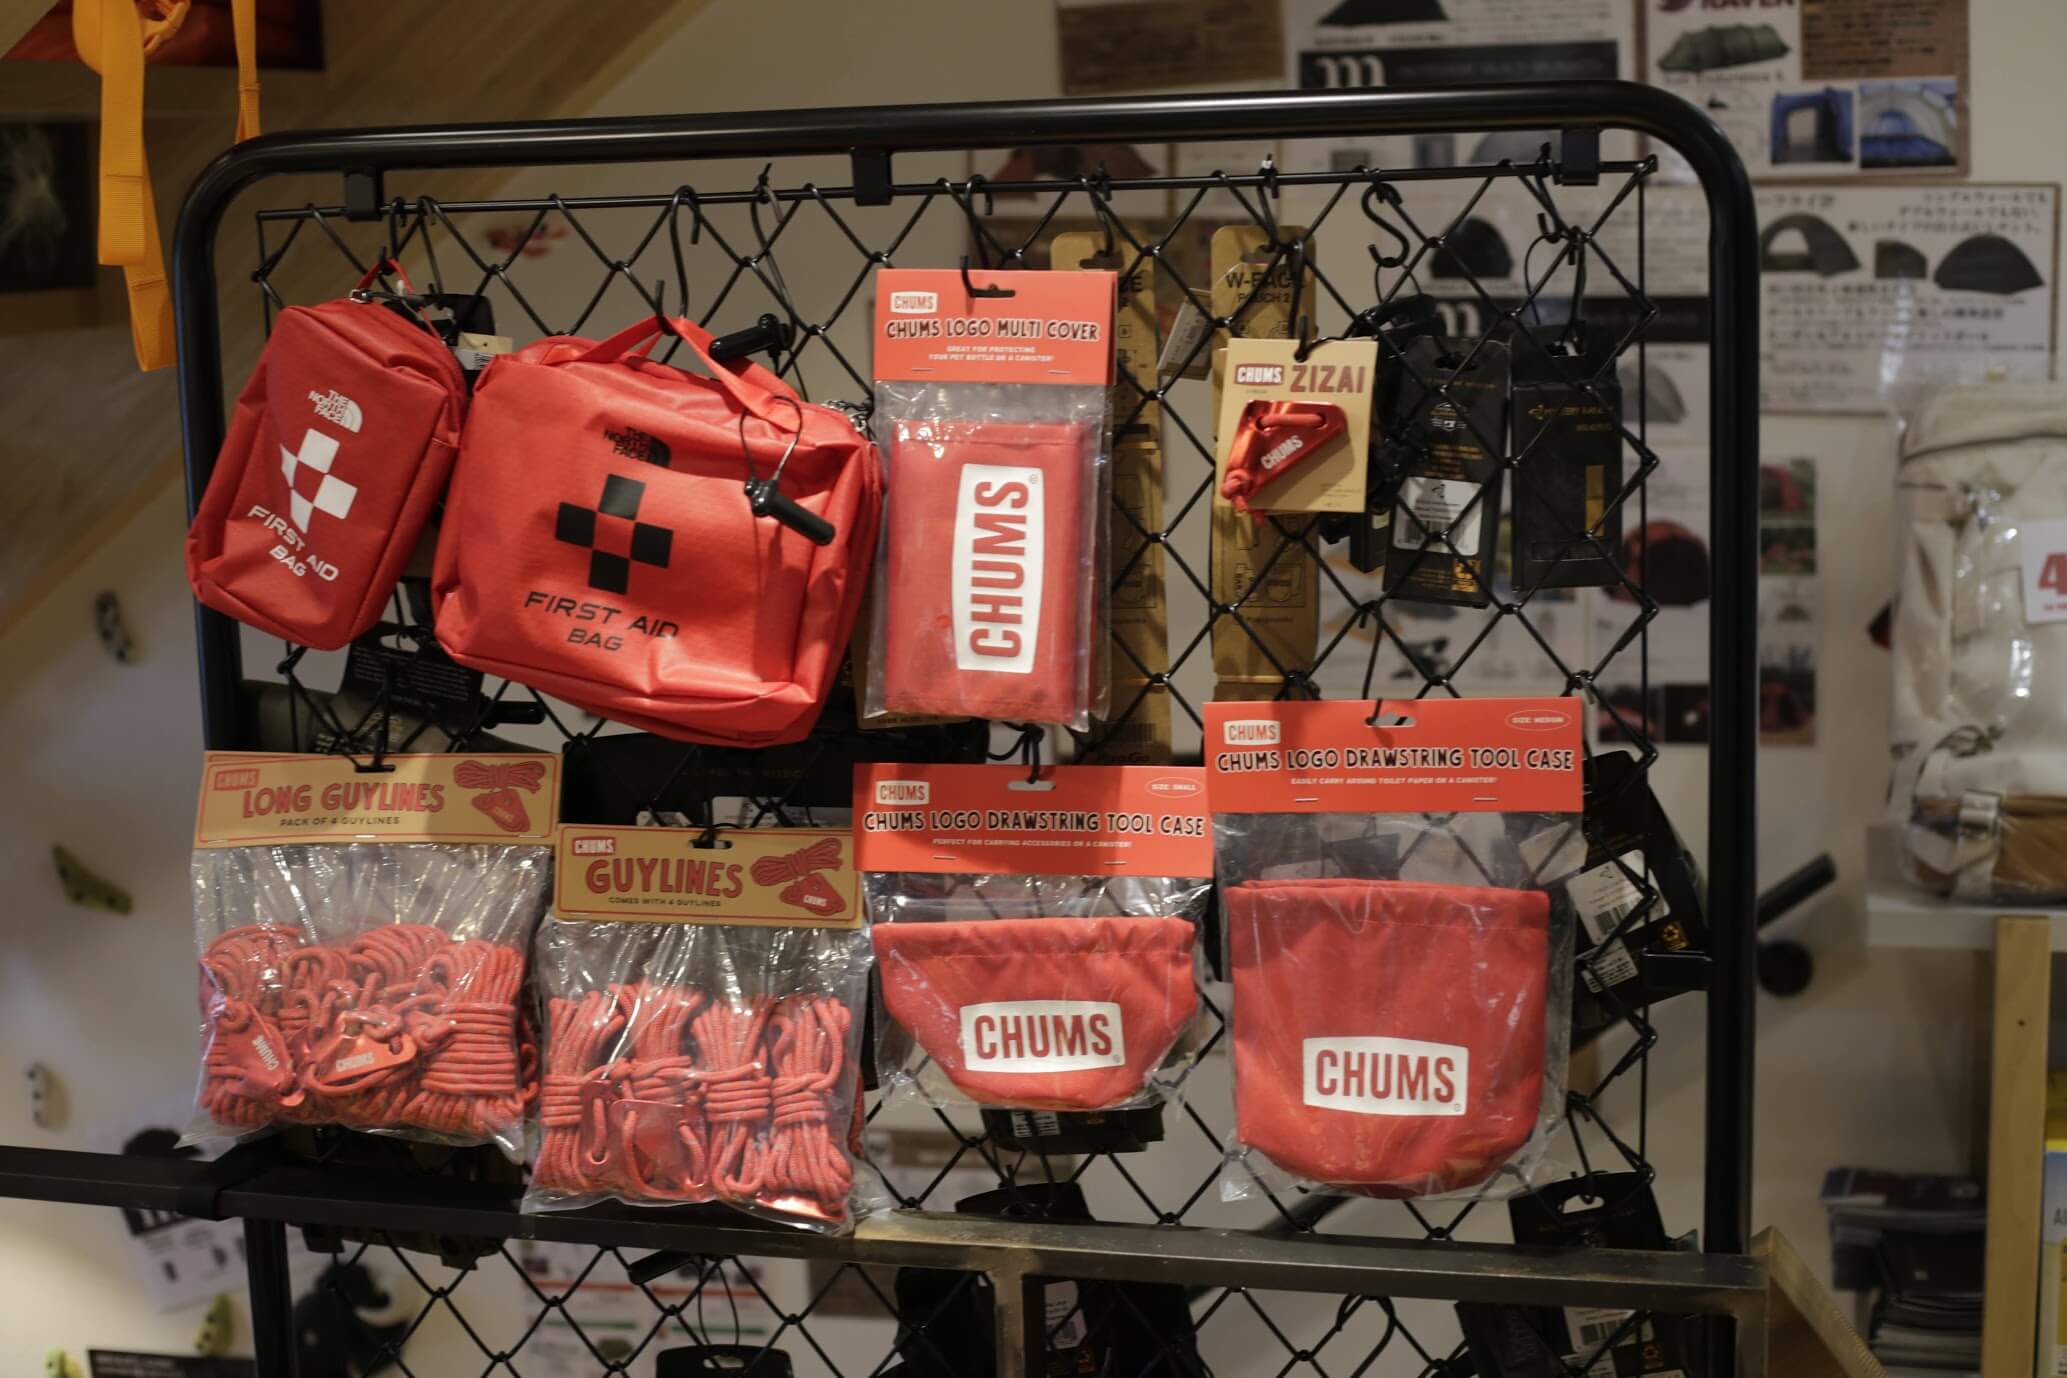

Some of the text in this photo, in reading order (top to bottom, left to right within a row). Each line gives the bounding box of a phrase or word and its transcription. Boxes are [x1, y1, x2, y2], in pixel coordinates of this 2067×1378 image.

[894, 295, 934, 310] CHUMS
[886, 318, 1099, 341] CHUMS LOGO MULTI COVER
[1237, 365, 1366, 393] CHUMS ZIZAI
[308, 390, 347, 413] NORTH
[327, 389, 349, 406] THE
[314, 404, 345, 426] FACE
[1260, 435, 1304, 470] CHUMS
[247, 504, 339, 582] FIRST AID
[269, 544, 307, 577] BAG
[969, 481, 1029, 658] CHUMS
[524, 591, 679, 639] FIRST AID
[567, 628, 624, 652] BAG
[1227, 724, 1277, 742] CHUMS
[1217, 747, 1573, 771] CHUMS LOGO DRAWSTRING TOOL CASE
[879, 784, 926, 802] CHUMS
[1319, 777, 1344, 785] CARRY
[1379, 777, 1406, 785] TOILET
[243, 782, 445, 818] LONG GUYLINES
[280, 816, 401, 827] PACK OF 4 GUYLINES
[863, 811, 1205, 837] CHUMS LOGO DRAWSTRING TOOL CASE
[574, 839, 615, 854] CHUMS
[932, 838, 966, 846] PERFECT
[967, 838, 983, 846] FOR
[984, 838, 1021, 846] CARRYING
[585, 857, 745, 899] GUYLINES
[608, 896, 640, 905] COMES
[642, 897, 667, 905] WITH
[676, 898, 721, 907] GUYLINES
[974, 1012, 1112, 1060] CHUMS
[1315, 1049, 1455, 1104] CHUMS
